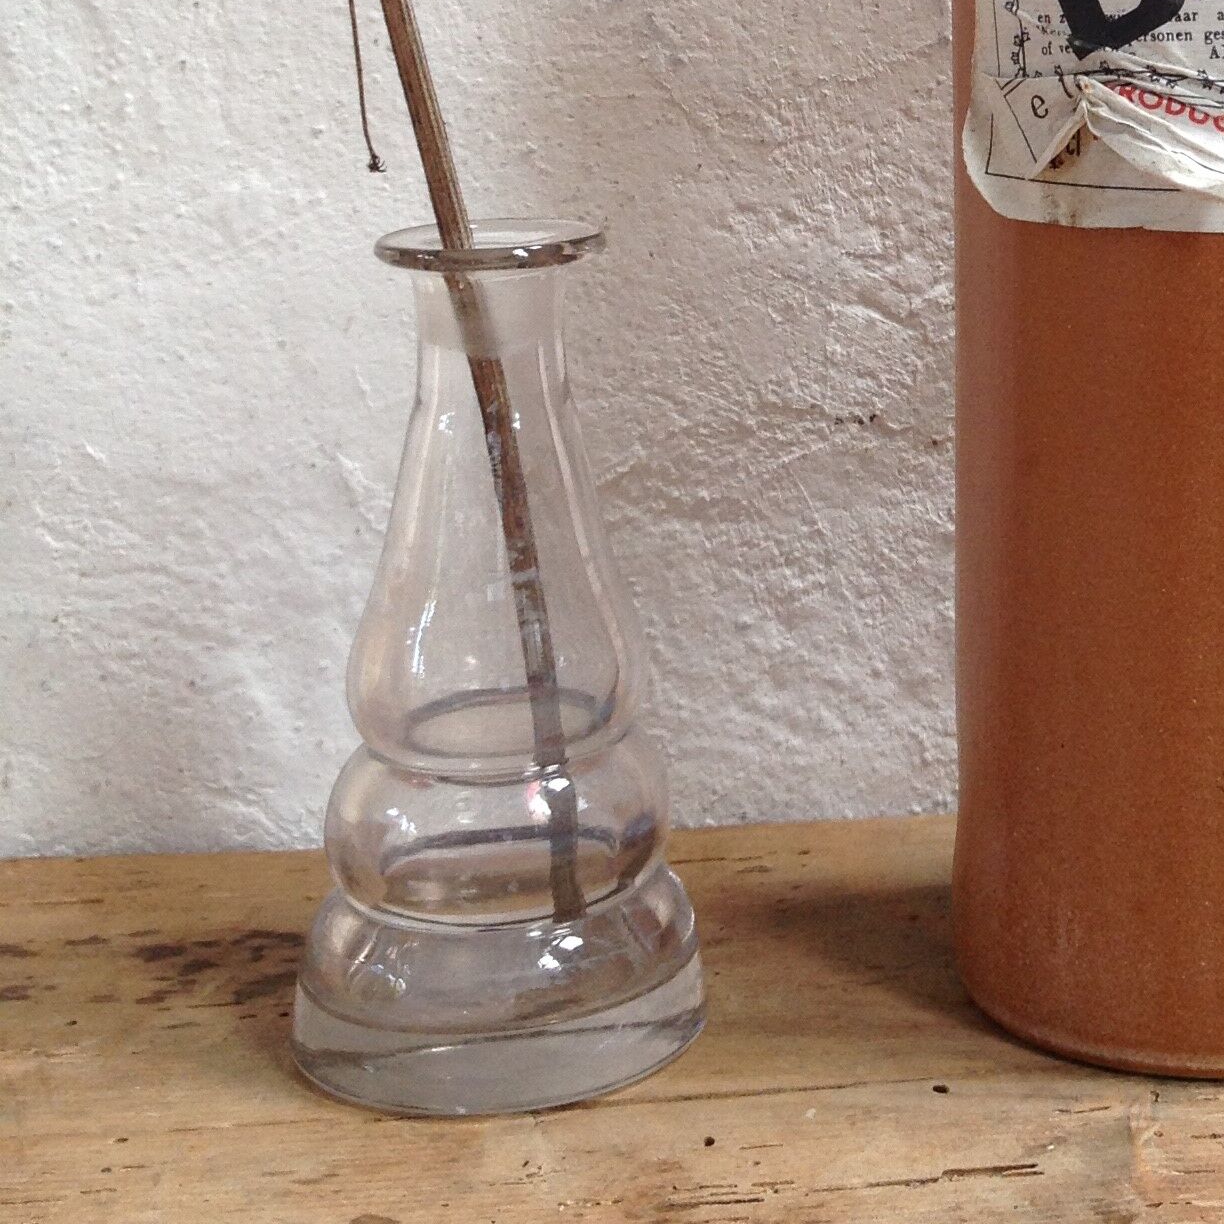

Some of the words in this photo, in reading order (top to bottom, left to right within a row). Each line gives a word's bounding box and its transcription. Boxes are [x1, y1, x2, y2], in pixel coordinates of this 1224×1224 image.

[1038, 14, 1050, 24] en
[1172, 12, 1198, 23] aar
[1135, 30, 1193, 42] ersonen
[1041, 42, 1053, 55] of
